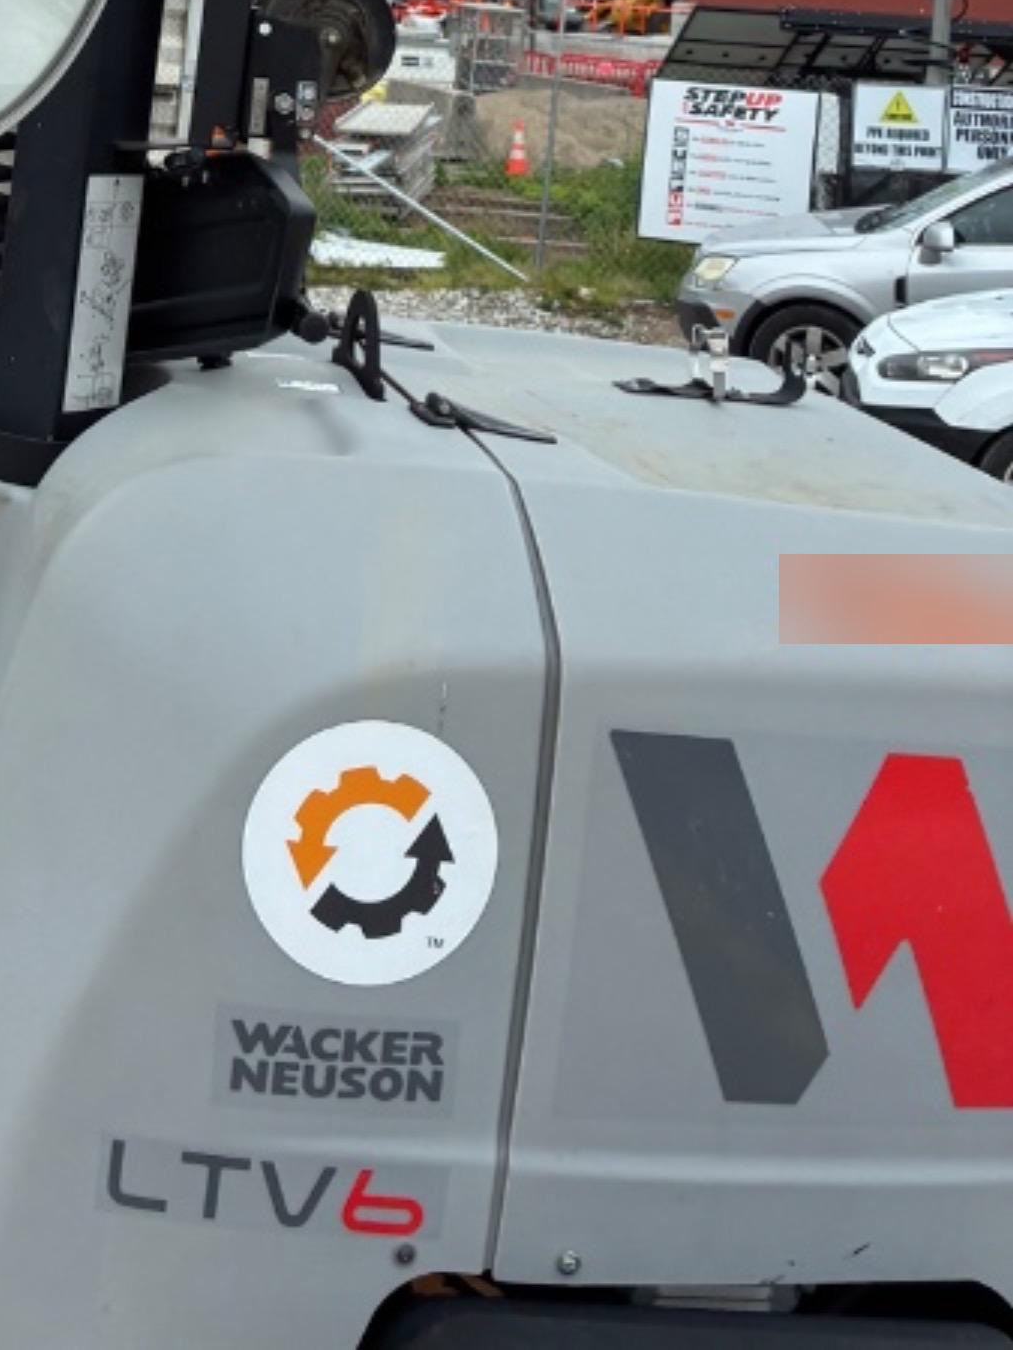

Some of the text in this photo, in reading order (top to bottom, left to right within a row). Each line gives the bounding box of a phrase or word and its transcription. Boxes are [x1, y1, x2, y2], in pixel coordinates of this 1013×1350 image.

[689, 102, 779, 122] SAFETY
[230, 1018, 445, 1066] WACKER
[229, 1060, 445, 1102] NEUSON
[107, 1139, 424, 1237] LTV6
